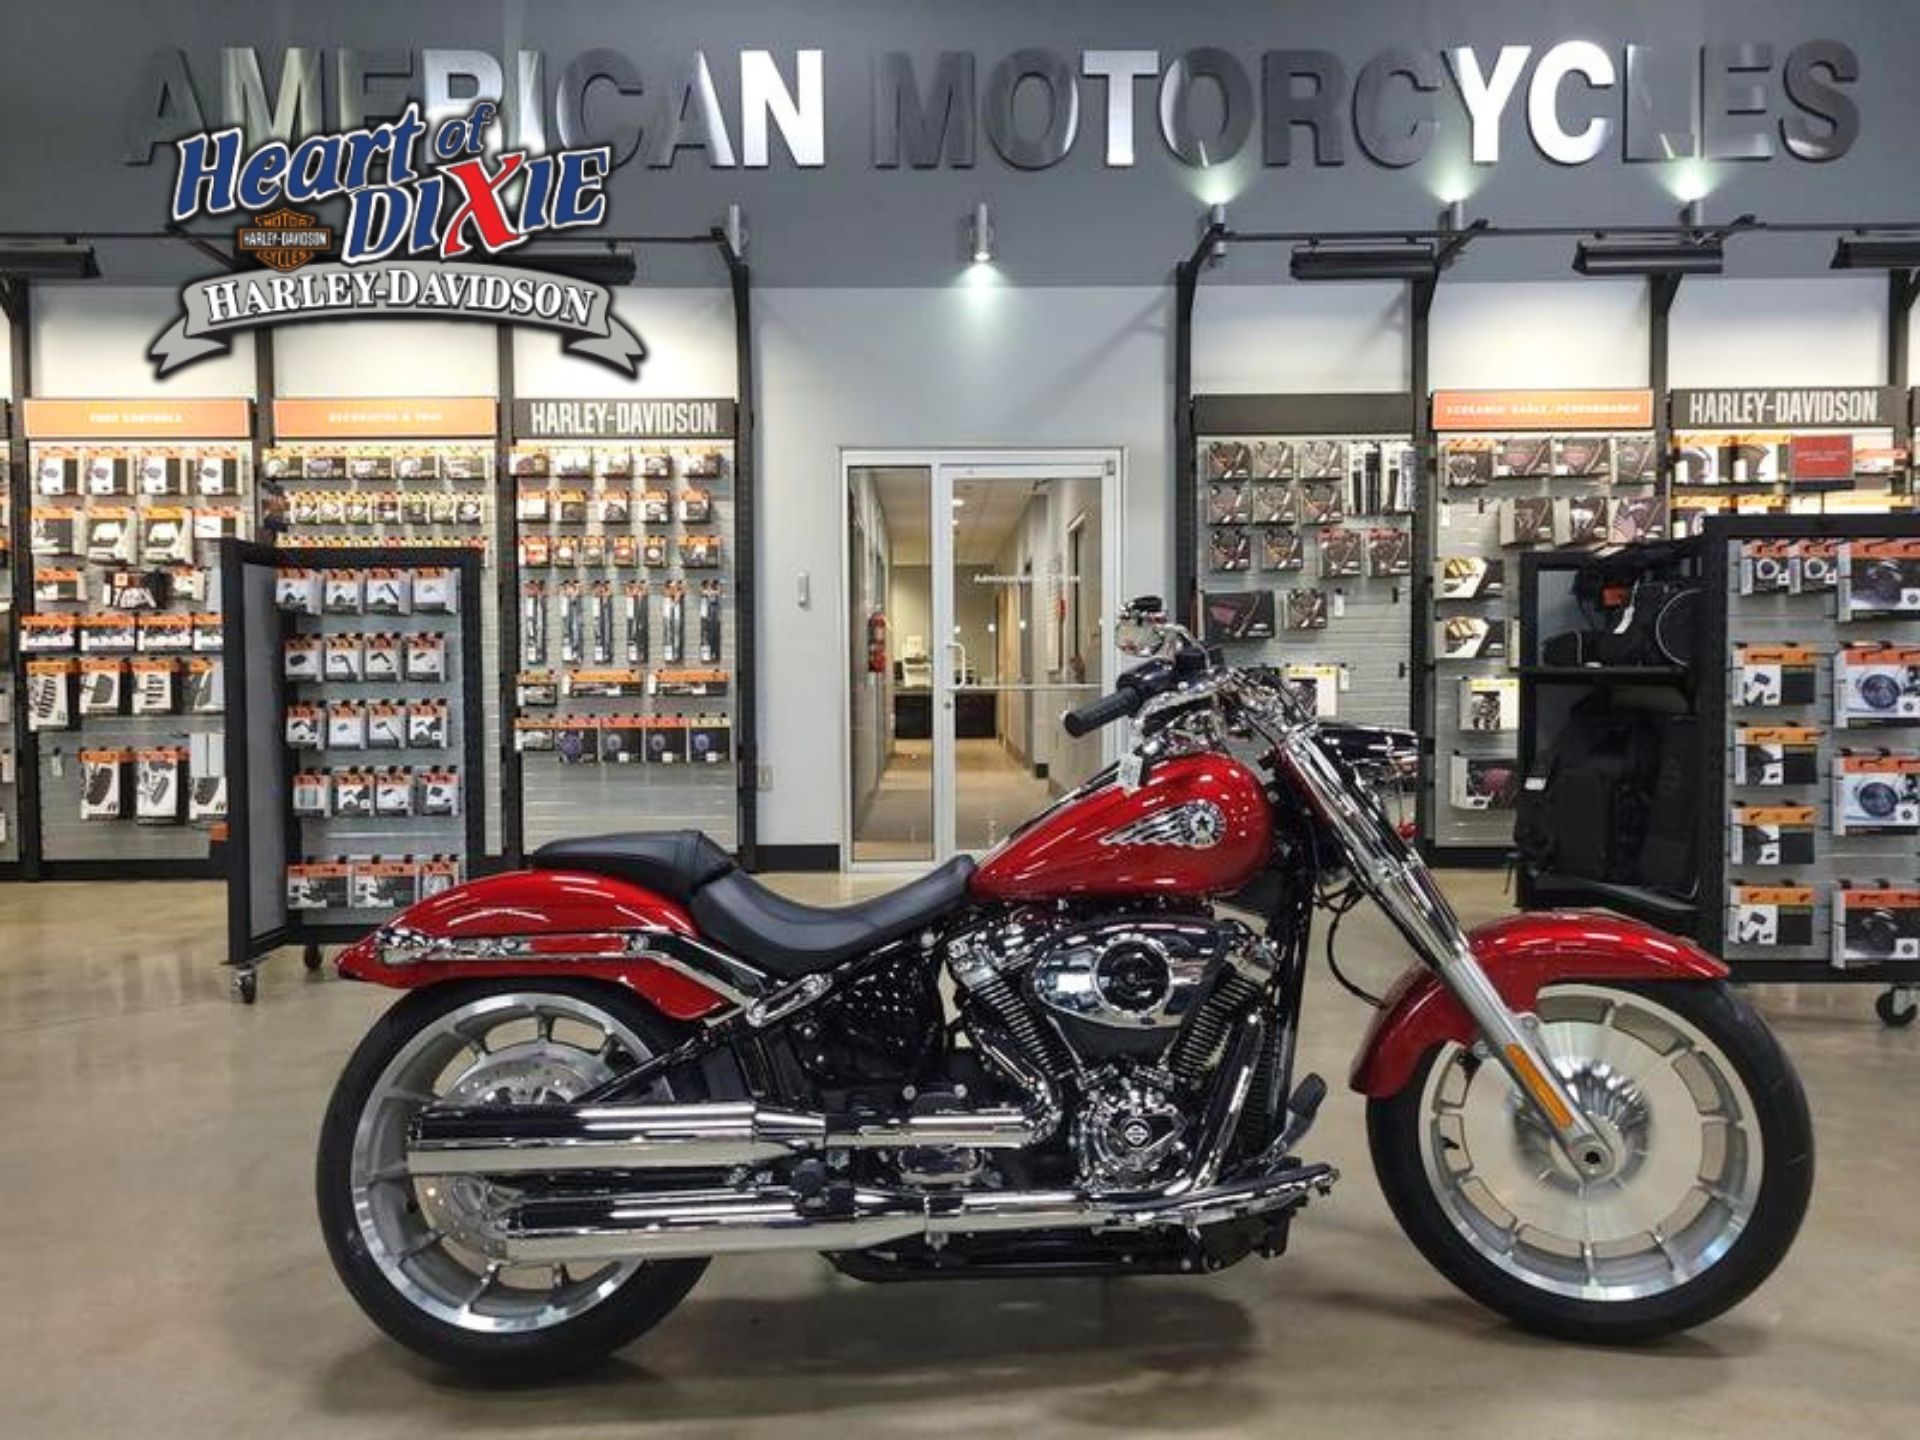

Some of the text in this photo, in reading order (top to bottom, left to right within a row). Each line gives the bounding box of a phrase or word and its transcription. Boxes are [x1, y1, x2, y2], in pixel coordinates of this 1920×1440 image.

[871, 40, 1860, 171] MOTORCYCLES
[530, 401, 718, 434] HARLEY-DAVIDSON
[1689, 390, 1878, 424] HARLEY-DAVIDSON
